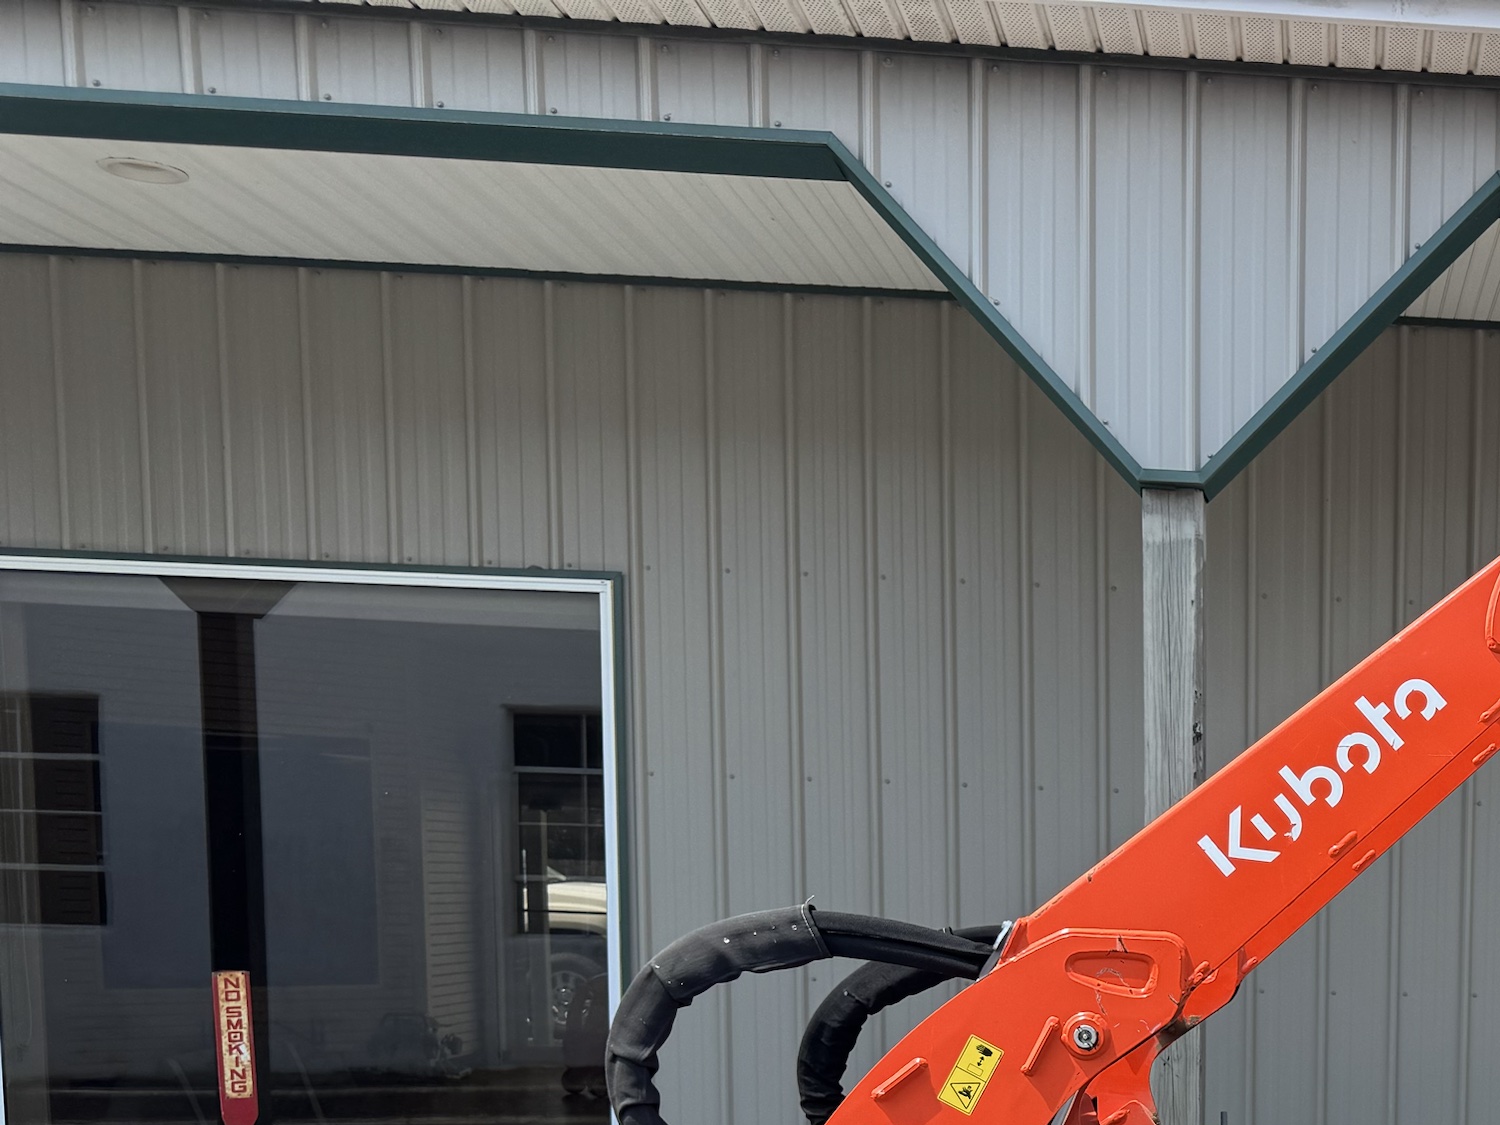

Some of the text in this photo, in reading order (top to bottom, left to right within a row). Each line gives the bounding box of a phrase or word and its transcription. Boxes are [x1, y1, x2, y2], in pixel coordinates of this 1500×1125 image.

[1197, 678, 1448, 878] Kubota
[224, 977, 247, 1093] NO SMOKING
